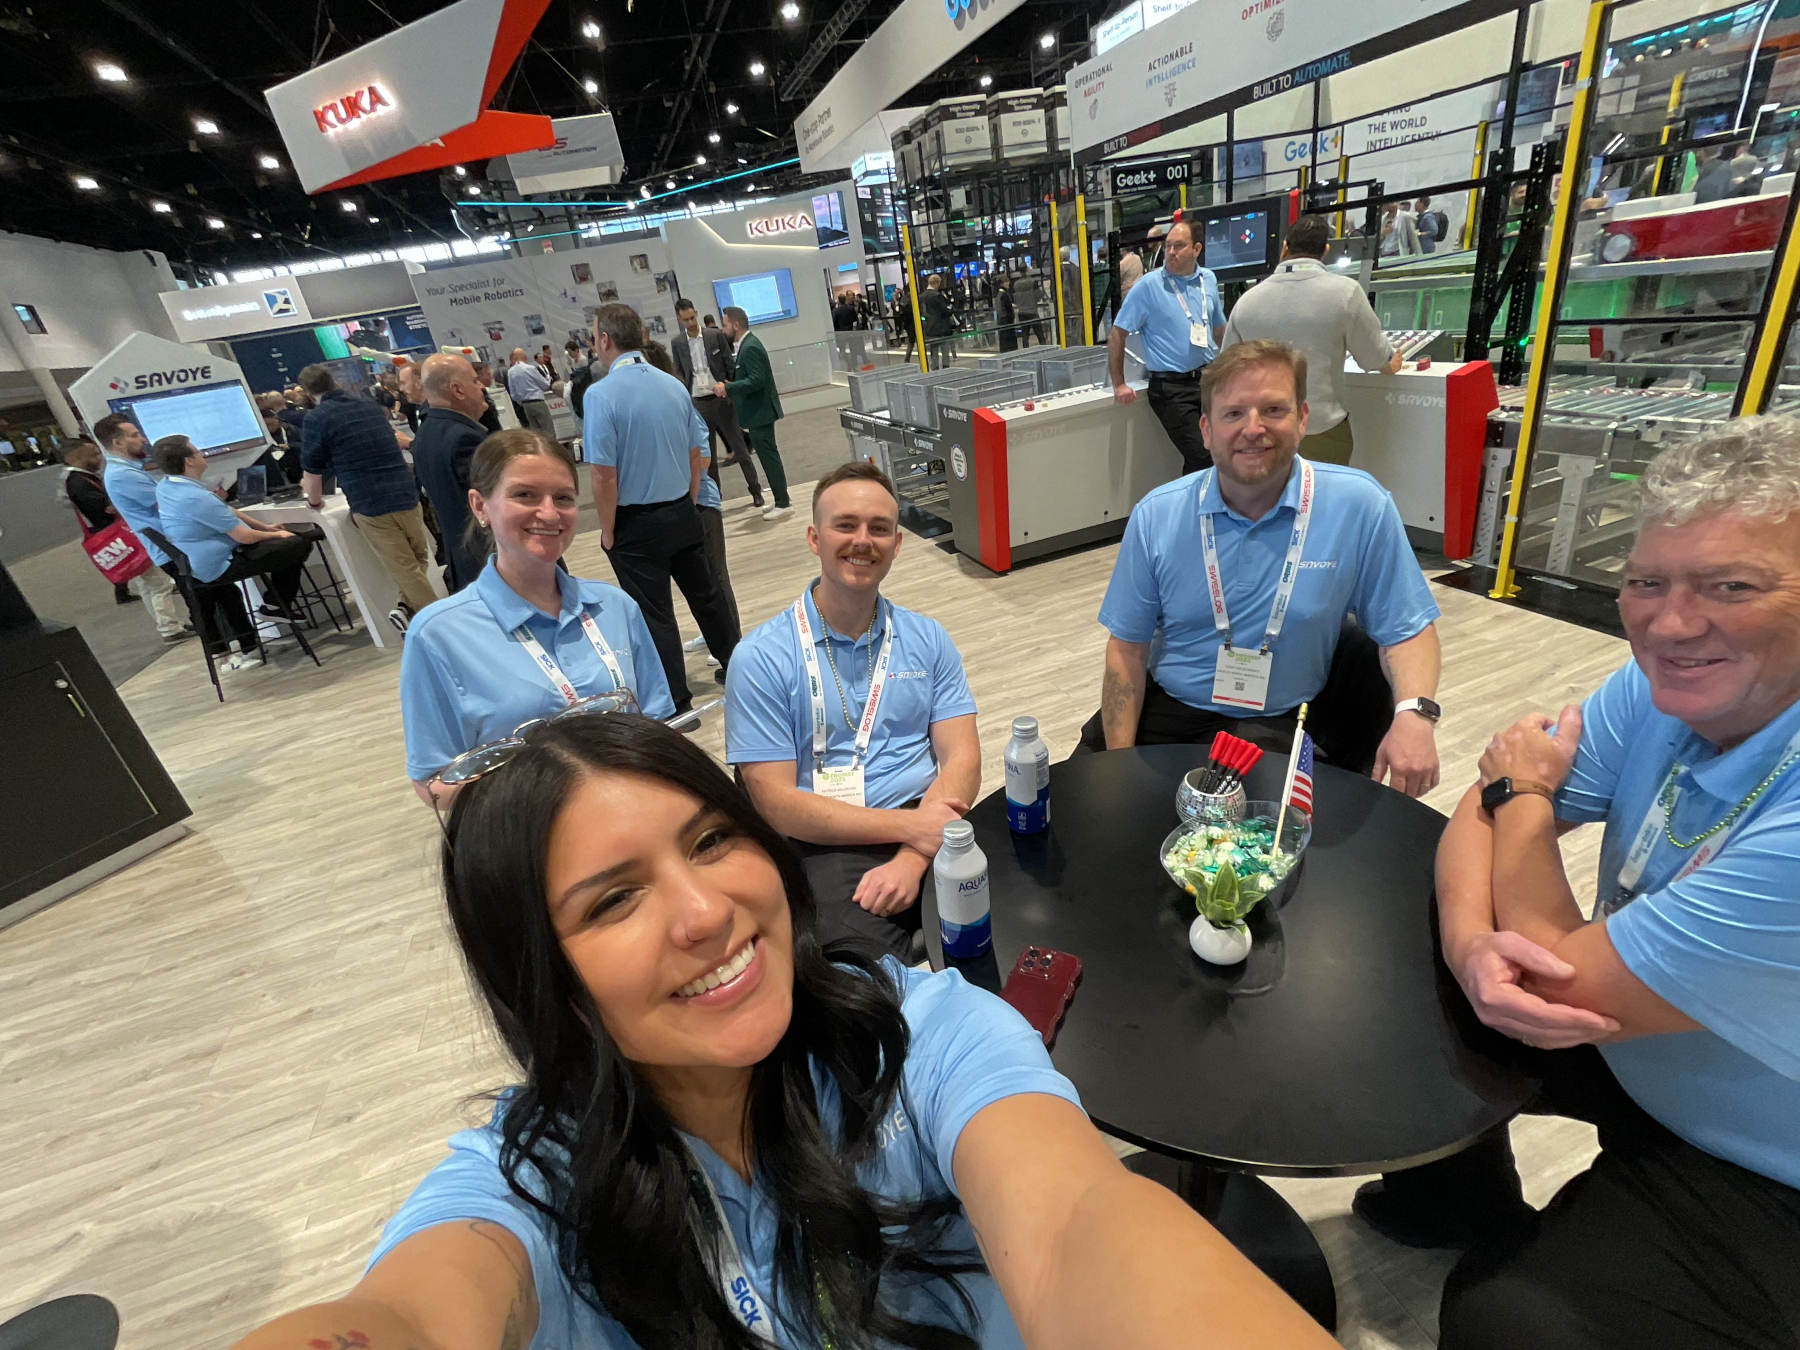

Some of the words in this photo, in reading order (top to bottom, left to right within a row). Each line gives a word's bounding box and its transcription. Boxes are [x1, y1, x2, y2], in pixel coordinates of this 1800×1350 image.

[1241, 0, 1284, 20] OPTIMI
[1148, 42, 1193, 72] ACTIONABLE
[1075, 63, 1113, 88] OPERATIONAL
[1146, 58, 1196, 88] INTELLIGENCE
[1084, 81, 1105, 98] AGILITY
[1253, 79, 1279, 100] BUILT
[1279, 74, 1292, 90] TO
[313, 86, 390, 133] KUKA
[1368, 123, 1387, 135] THE
[1390, 116, 1428, 131] WORLD
[1103, 141, 1119, 154] BUILT
[1120, 136, 1128, 148] TO
[1116, 169, 1157, 187] Geek+
[1166, 164, 1188, 180] 001
[748, 215, 813, 236] KUKA
[425, 286, 446, 297] Your
[448, 278, 490, 293] Specialist
[493, 277, 505, 288] for
[450, 295, 481, 307] Mobile
[484, 287, 525, 302] Robotics
[134, 366, 212, 390] SAVOYE
[1208, 564, 1224, 614] SWISSLOG
[541, 653, 555, 670] SICK
[862, 683, 881, 733] SWISSLOG
[959, 870, 989, 893] AQUA
[731, 1275, 762, 1327] SICK
